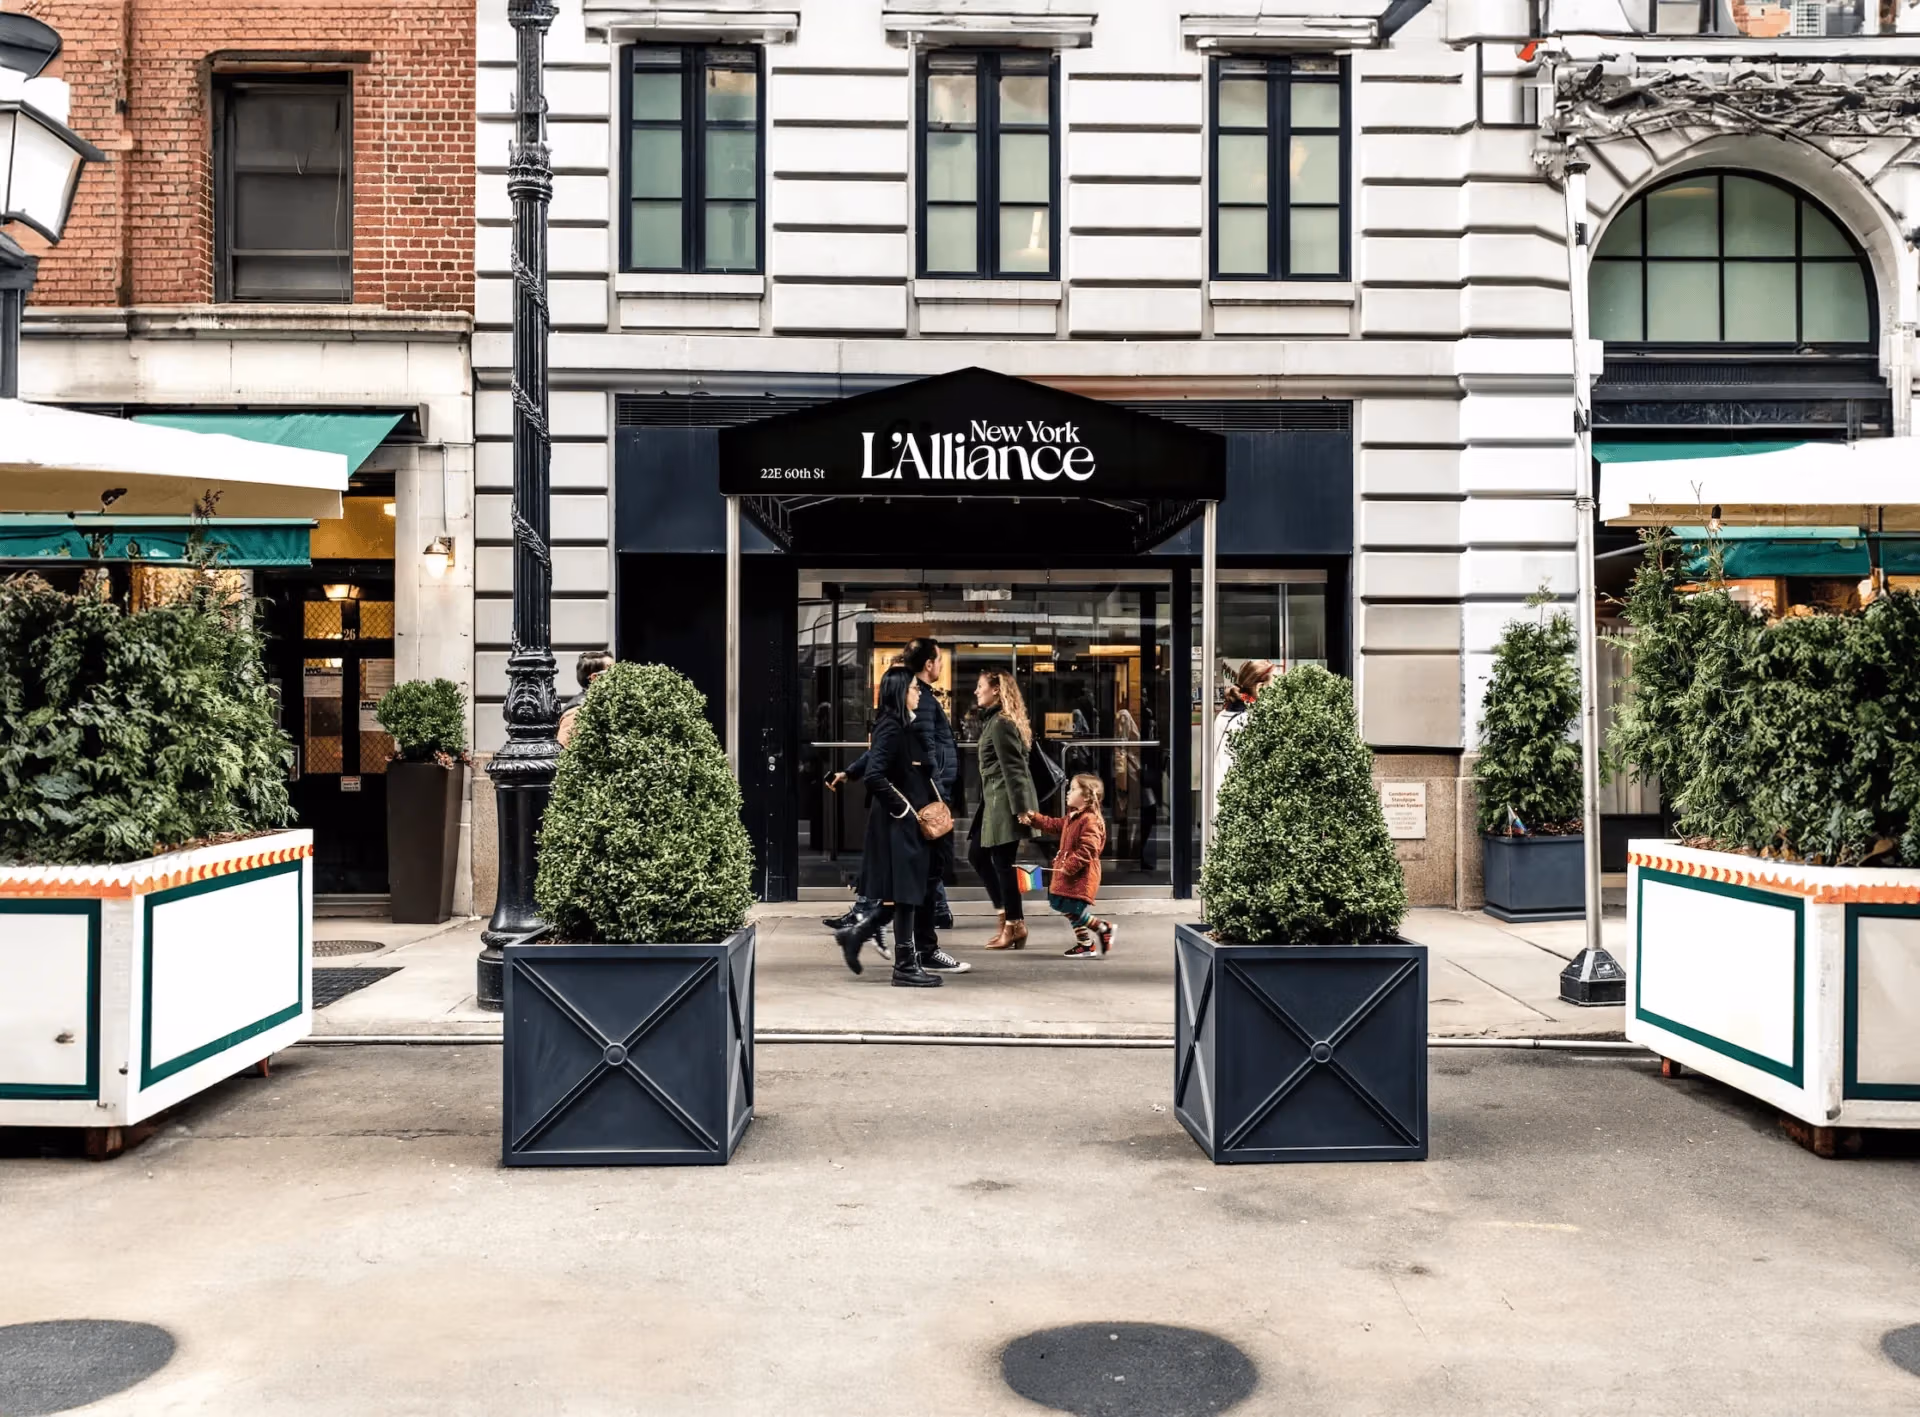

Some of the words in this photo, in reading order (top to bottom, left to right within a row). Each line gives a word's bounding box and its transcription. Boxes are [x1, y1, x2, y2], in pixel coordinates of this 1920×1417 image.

[970, 420, 1023, 443] New
[1026, 420, 1081, 443] York
[861, 431, 1096, 481] L'Alliance
[760, 467, 783, 479] 22E
[784, 467, 812, 479] 60th
[813, 467, 826, 479] St
[343, 628, 356, 641] 26
